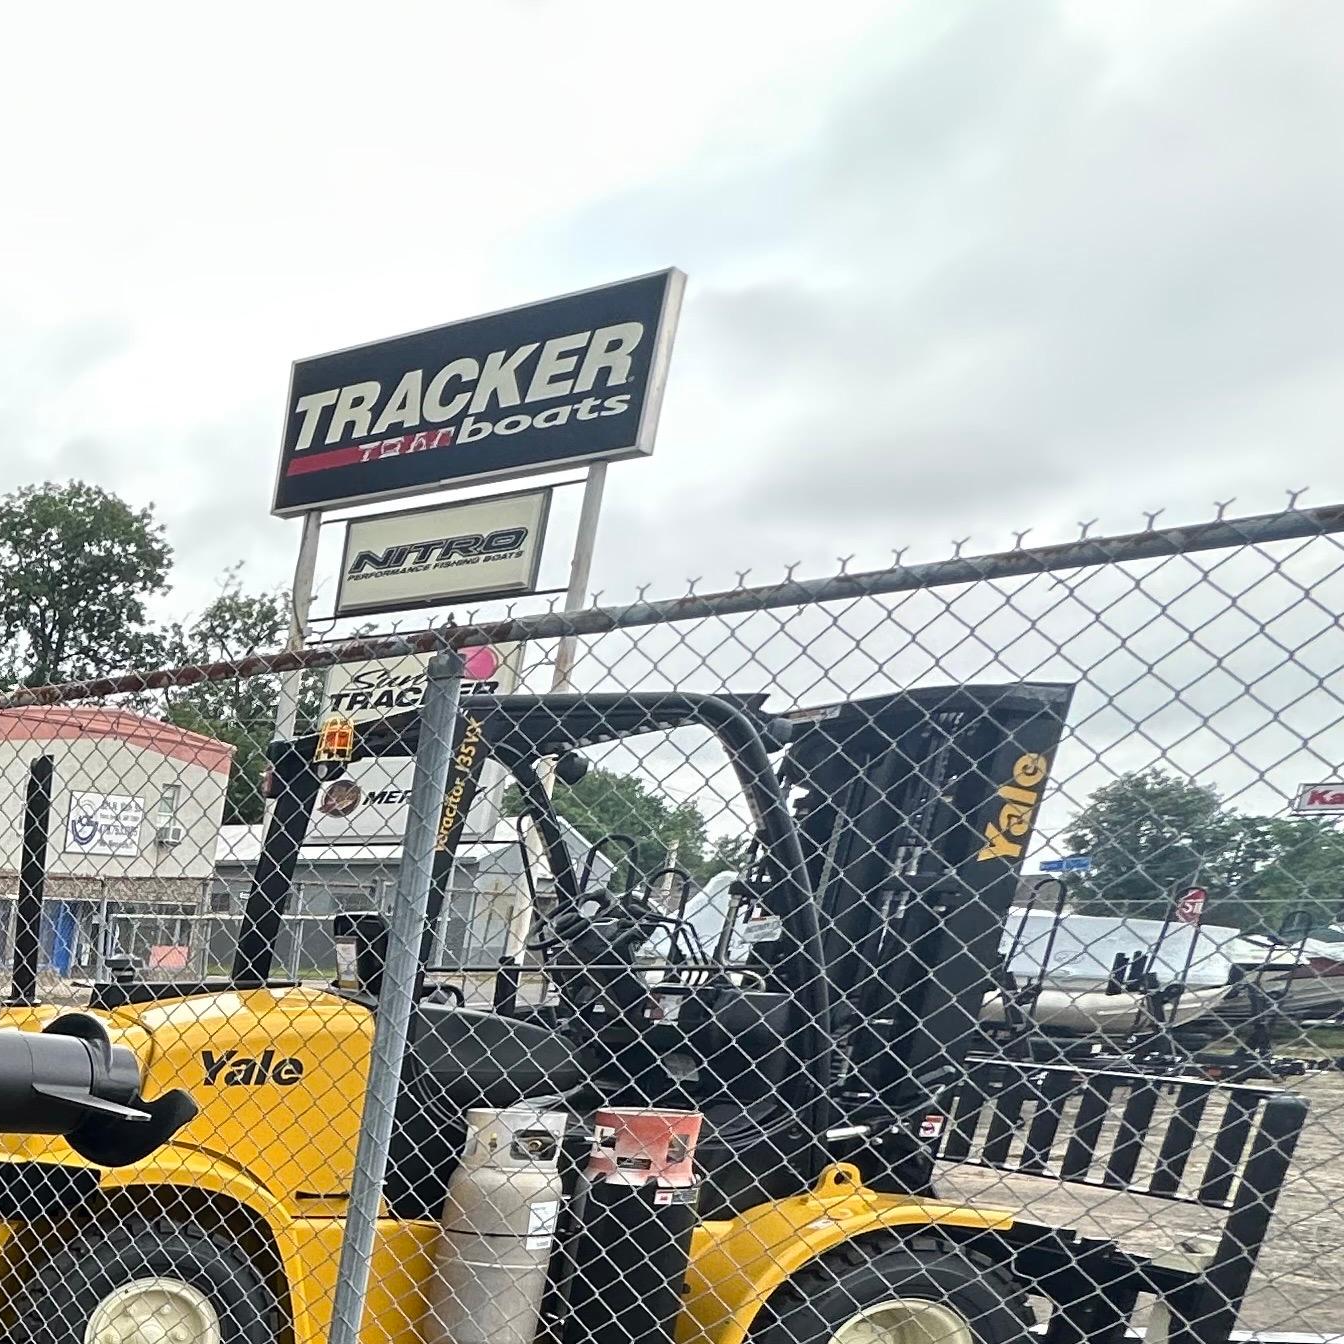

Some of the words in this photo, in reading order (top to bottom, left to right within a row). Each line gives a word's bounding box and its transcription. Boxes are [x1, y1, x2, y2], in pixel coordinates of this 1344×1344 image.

[294, 322, 644, 451] TRACKER
[456, 394, 631, 445] boats
[346, 562, 432, 582] PERFORMANCE
[432, 555, 481, 570] FISHING
[482, 549, 525, 564] BOATS
[348, 527, 529, 574] NITRO
[976, 752, 1048, 863] Yale
[201, 1049, 305, 1087] Yale
